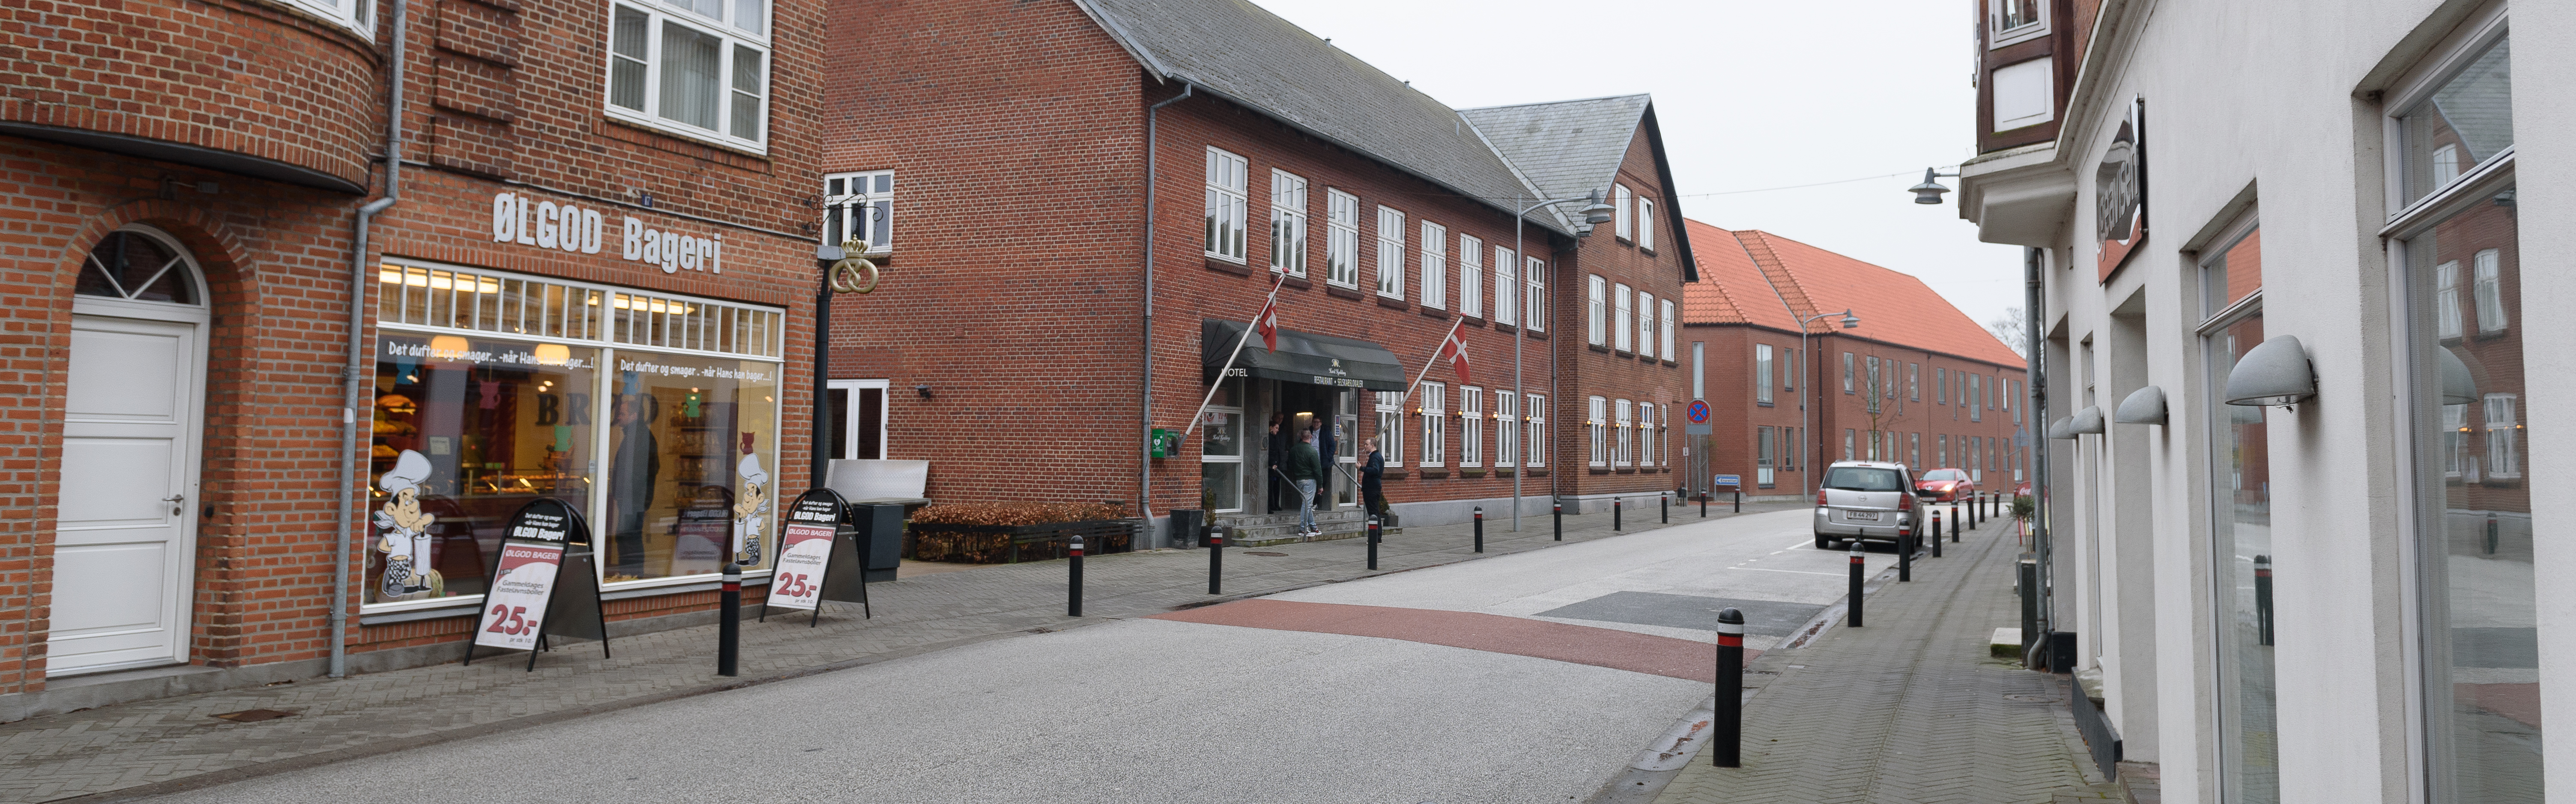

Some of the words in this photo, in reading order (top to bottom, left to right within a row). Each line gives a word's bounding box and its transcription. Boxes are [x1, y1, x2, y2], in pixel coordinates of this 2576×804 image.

[2098, 142, 2138, 262] geavisen
[493, 192, 602, 255] ØLGOD
[623, 215, 721, 274] Bageri
[388, 341, 407, 356] Det
[409, 344, 442, 358] dufter
[443, 349, 454, 362] og
[519, 351, 540, 365] Hans
[621, 359, 634, 371] Det
[635, 361, 659, 373] dufter
[660, 365, 669, 376] og
[716, 367, 733, 378] Hans
[734, 368, 745, 379] han
[1314, 375, 1333, 385] RESTAURANT
[1337, 378, 1363, 387] SELSKABSLOKALER
[794, 511, 814, 520] ØLGOD
[814, 512, 836, 522] Bageri
[513, 526, 538, 538] ØLGOD
[537, 528, 566, 541] Bageri
[505, 549, 532, 558] ØLGOD
[532, 552, 559, 560] BAGERI
[497, 587, 544, 596] Fastelavnsboller
[502, 580, 544, 590] Gammeldages
[776, 572, 817, 598] 25.-
[487, 604, 537, 635] 25.-
